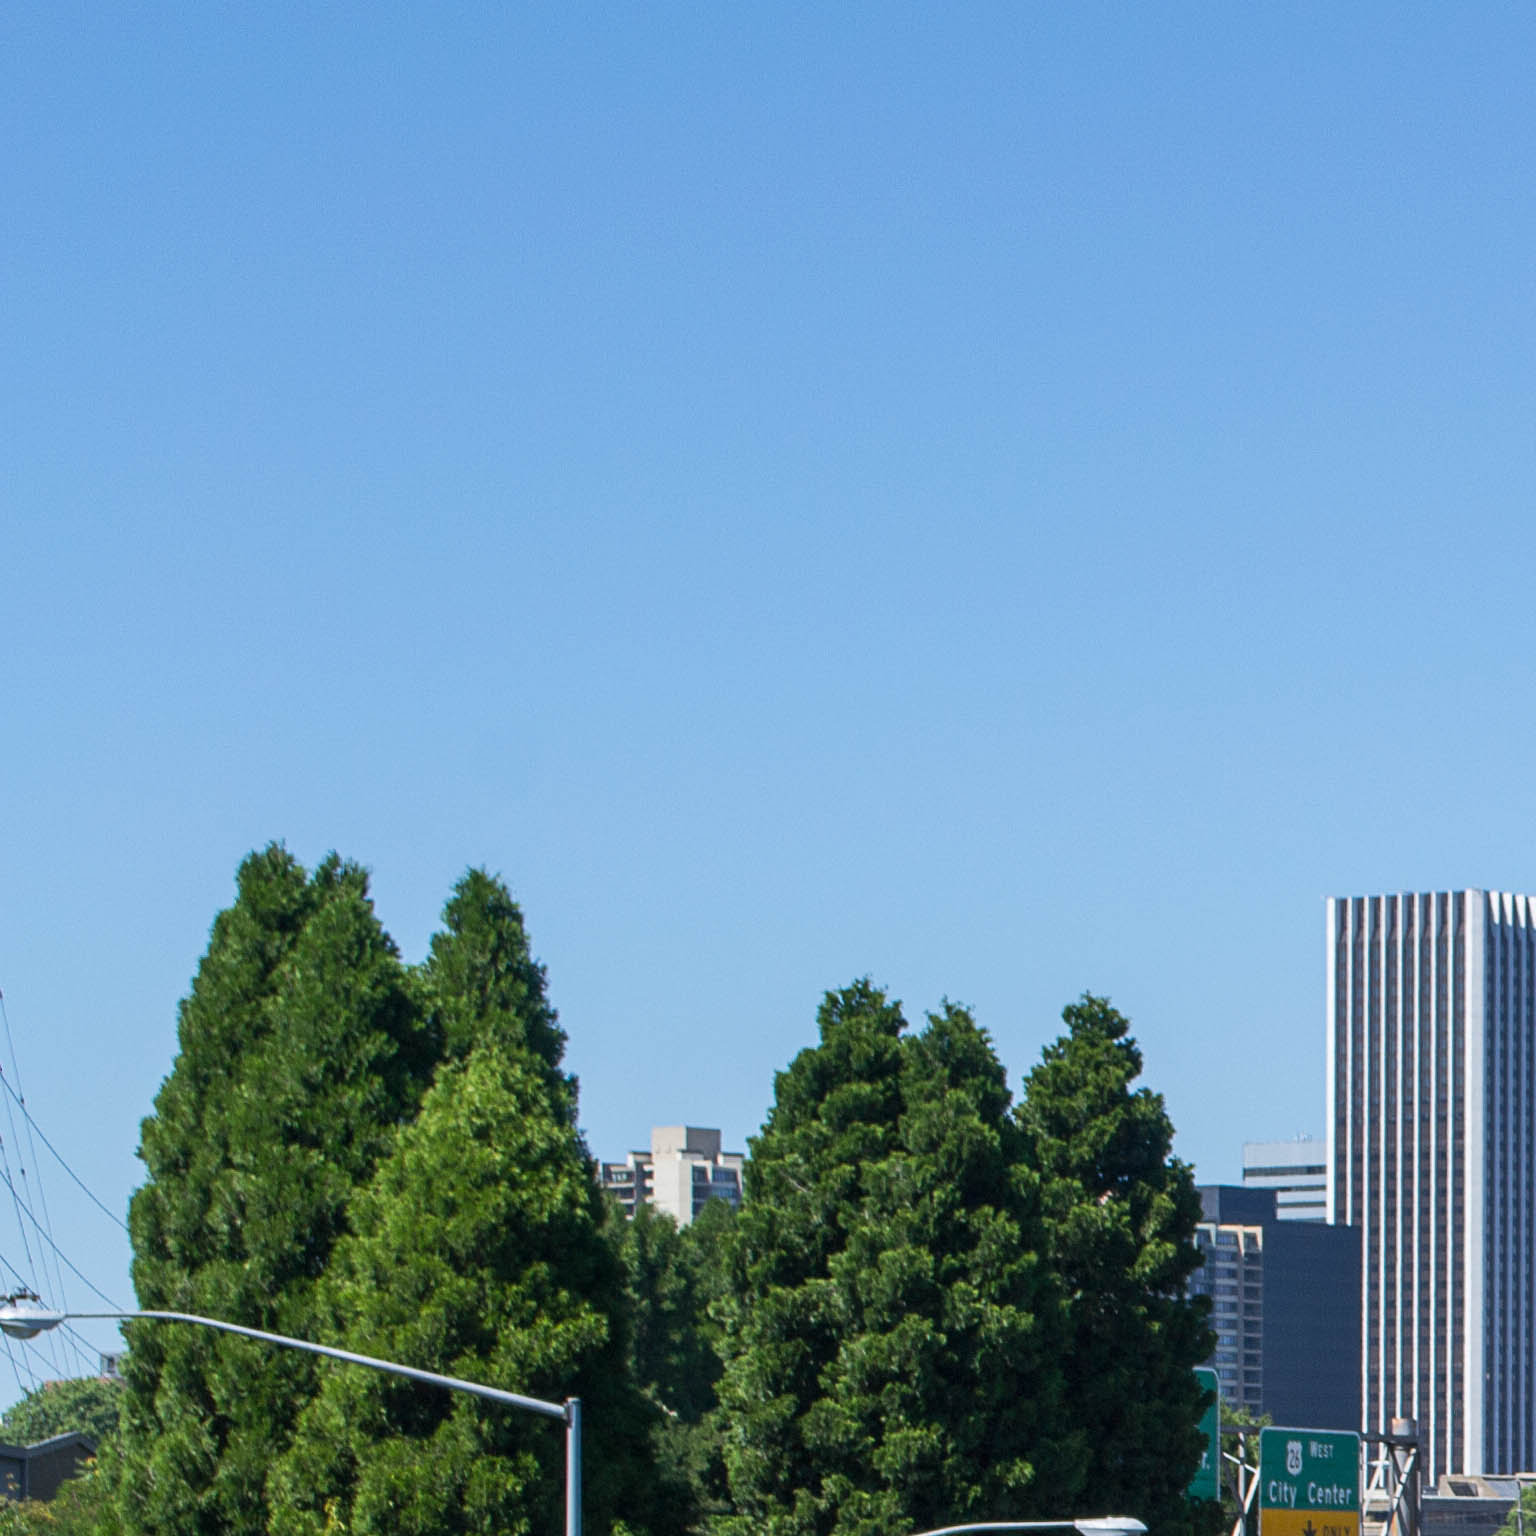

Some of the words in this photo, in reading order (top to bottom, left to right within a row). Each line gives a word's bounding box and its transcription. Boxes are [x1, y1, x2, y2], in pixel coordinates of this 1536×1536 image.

[1288, 1447, 1301, 1470] 26
[1309, 1440, 1335, 1459] WEST
[1268, 1479, 1298, 1510] City
[1307, 1480, 1353, 1505] Center
